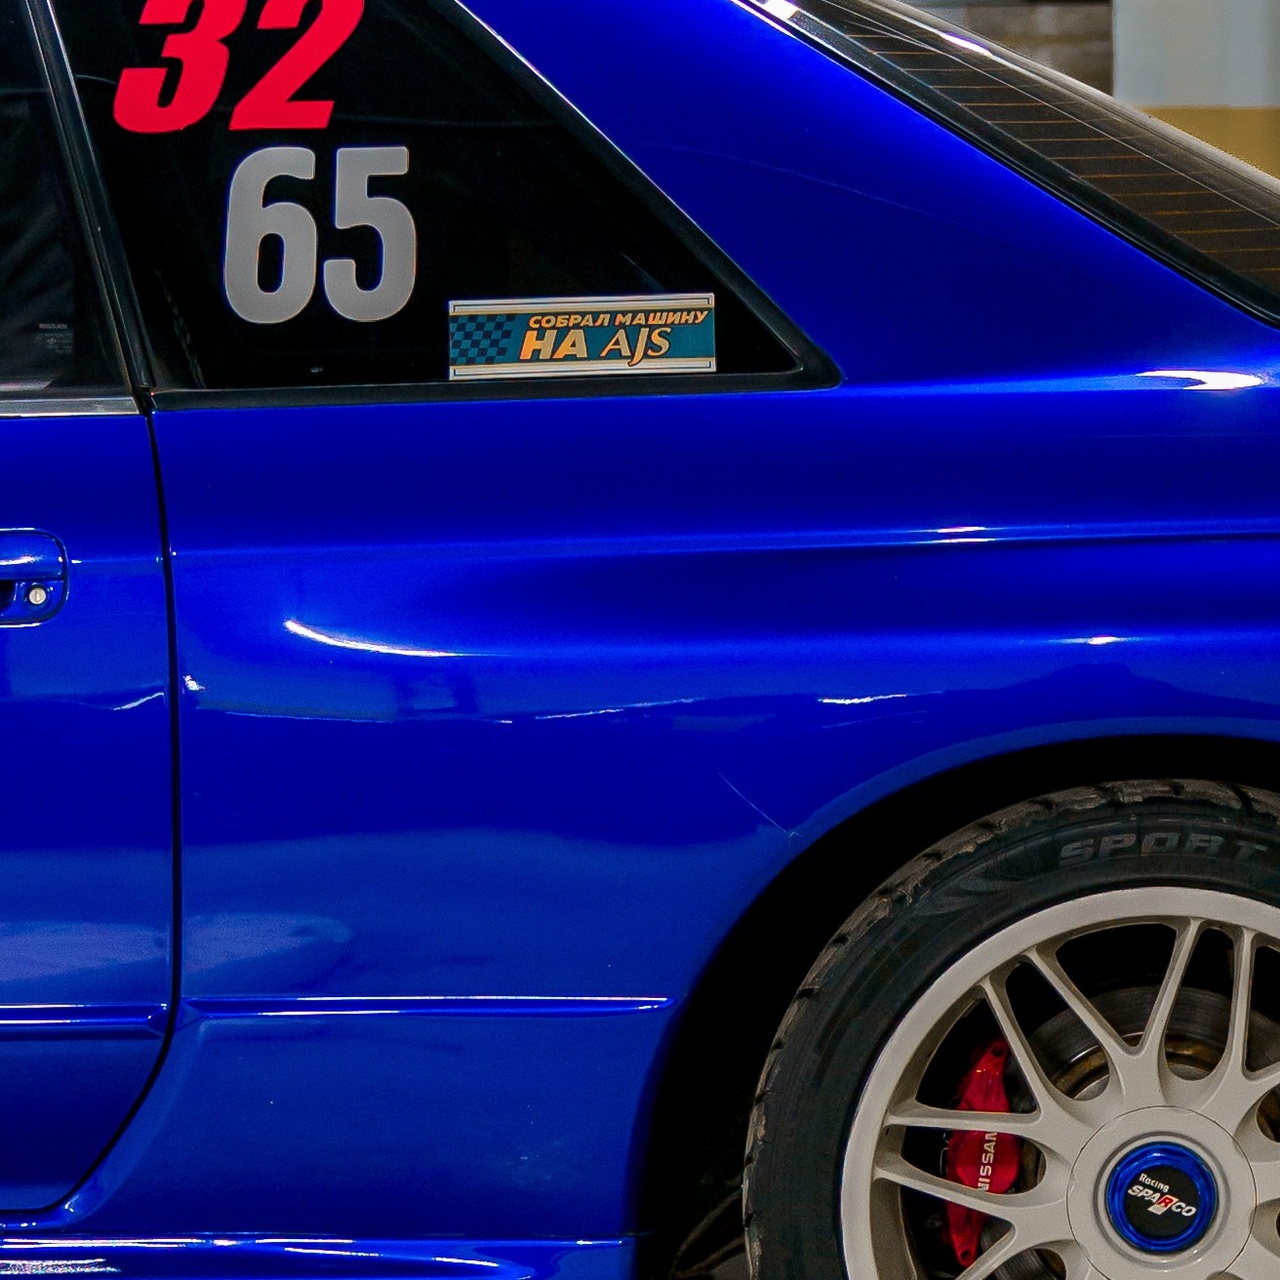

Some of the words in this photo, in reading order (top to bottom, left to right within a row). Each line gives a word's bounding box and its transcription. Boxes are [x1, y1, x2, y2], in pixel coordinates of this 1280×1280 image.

[224, 146, 417, 324] 65
[528, 313, 611, 329] СОБРАЛ
[614, 310, 710, 327] МАШИНУ
[519, 328, 589, 360] НА
[599, 326, 672, 367] AJS
[1058, 831, 1269, 867] SPORT
[1127, 1184, 1197, 1216] SPARCO
[1139, 1173, 1170, 1193] Racing
